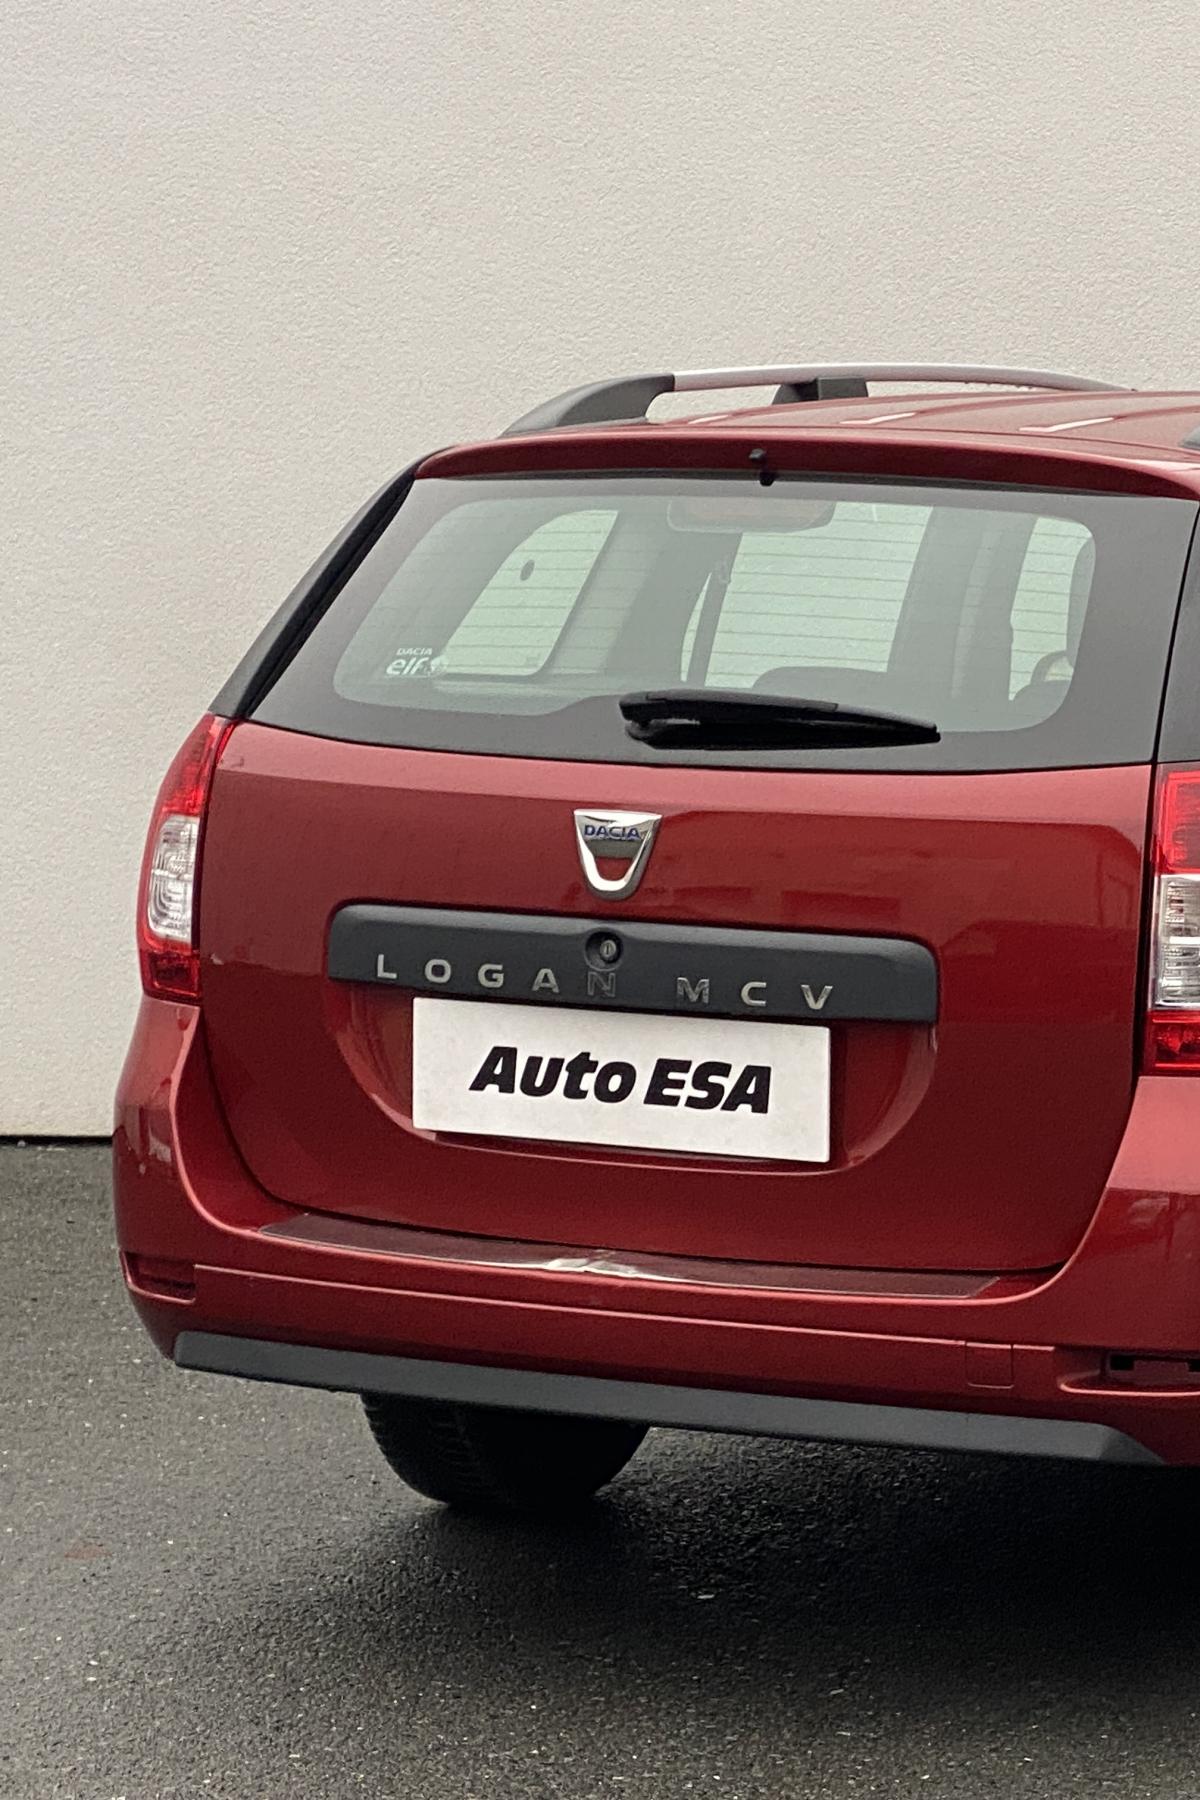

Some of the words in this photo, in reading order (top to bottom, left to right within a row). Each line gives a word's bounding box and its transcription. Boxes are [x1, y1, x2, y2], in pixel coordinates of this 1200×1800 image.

[396, 647, 433, 656] DACIA
[583, 825, 640, 839] DACIA
[375, 953, 617, 999] LOGAN
[676, 976, 834, 1011] MCV
[469, 1046, 638, 1102] Auto
[643, 1058, 772, 1114] ESA
